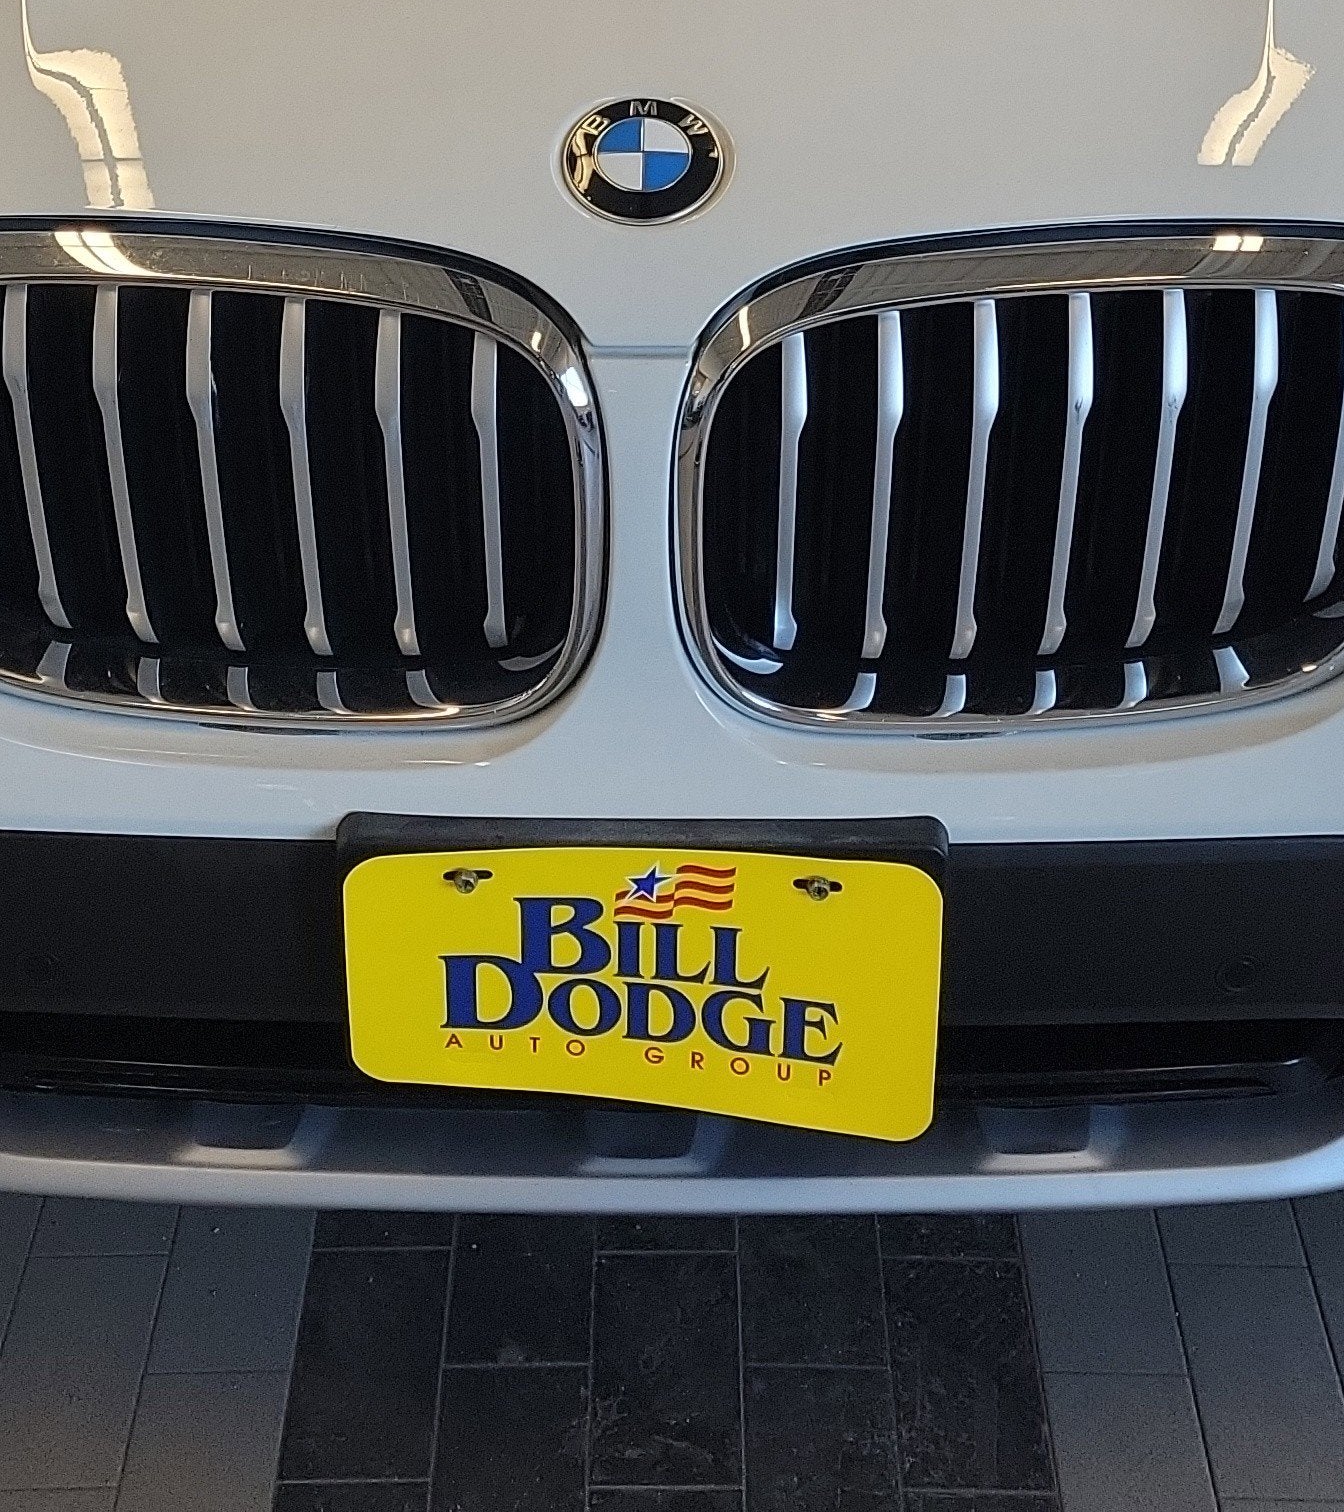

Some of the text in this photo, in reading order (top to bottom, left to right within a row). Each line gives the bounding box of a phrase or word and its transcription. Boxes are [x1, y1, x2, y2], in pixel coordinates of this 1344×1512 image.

[581, 100, 709, 136] BMW
[512, 896, 771, 991] BILL
[438, 954, 844, 1065] DODGE
[444, 1032, 833, 1086] AUTO GROUP
